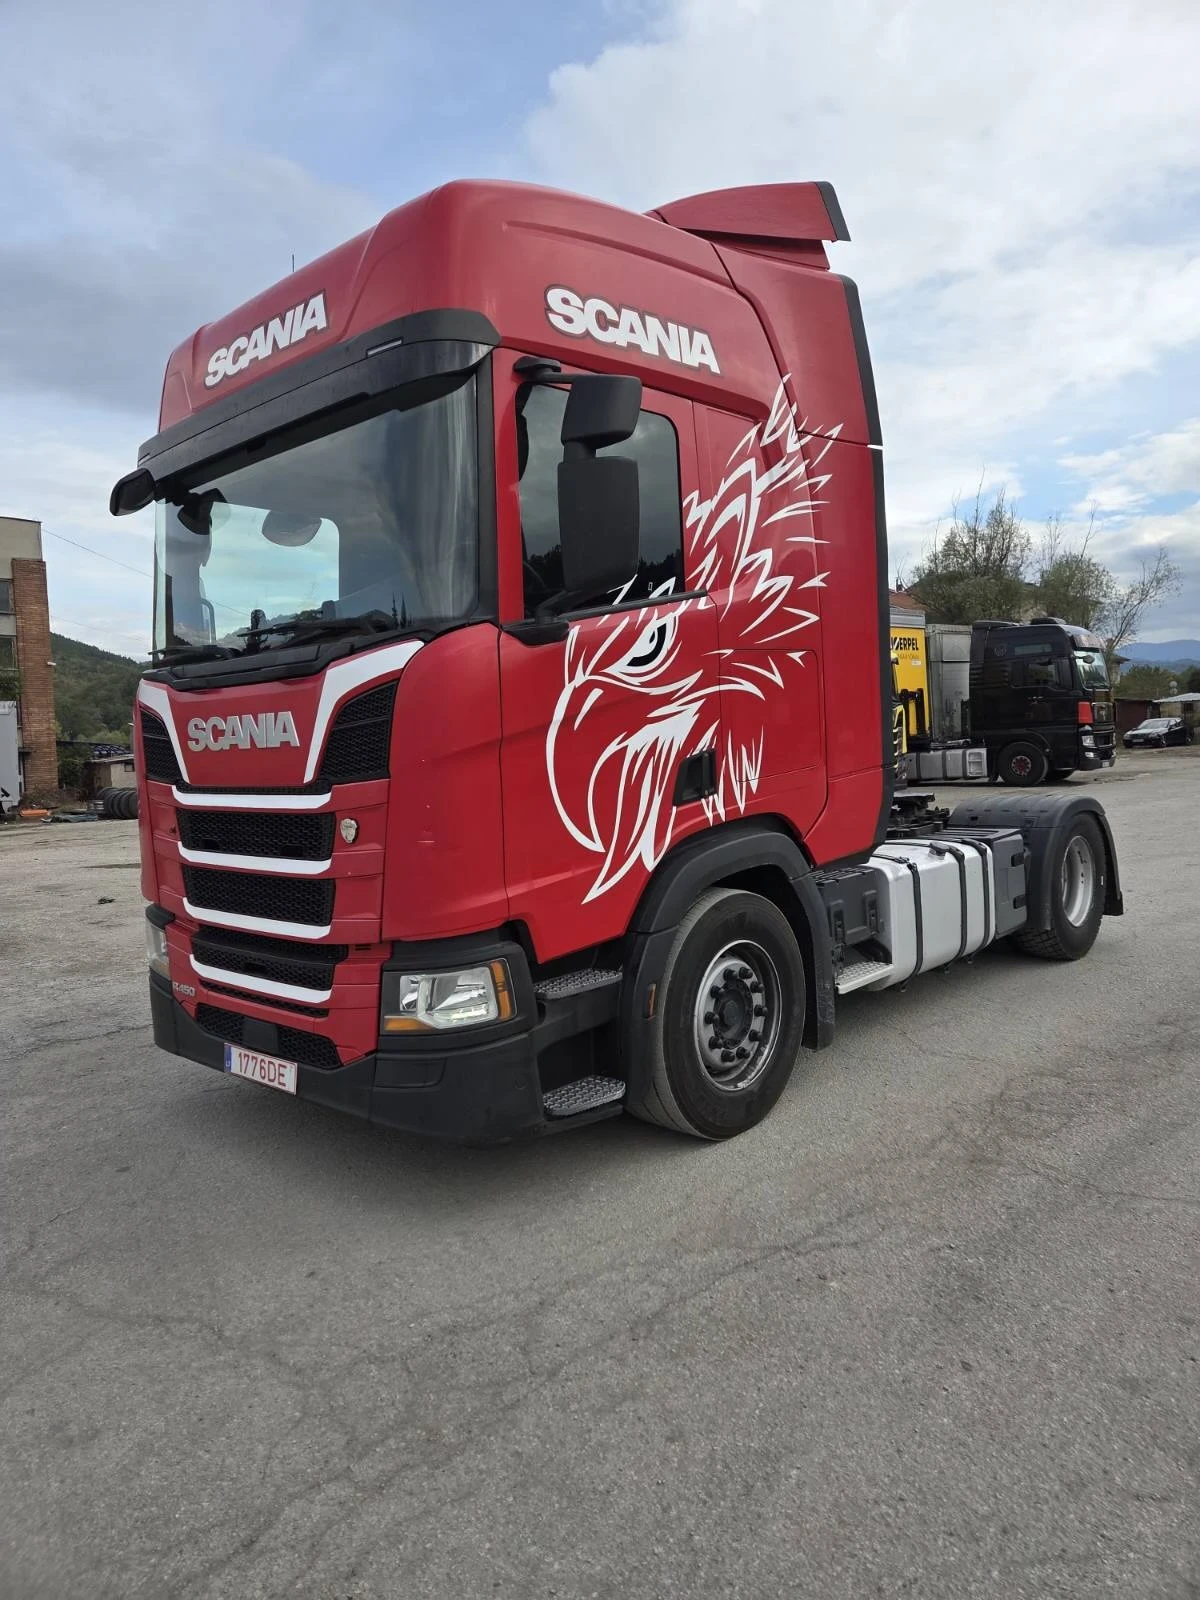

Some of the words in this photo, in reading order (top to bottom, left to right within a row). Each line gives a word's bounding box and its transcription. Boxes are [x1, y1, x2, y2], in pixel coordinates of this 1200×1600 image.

[204, 293, 328, 387] SCANIA
[545, 286, 721, 375] SCANIA
[187, 710, 300, 752] SCANIA
[238, 1051, 288, 1087] 1776DE
